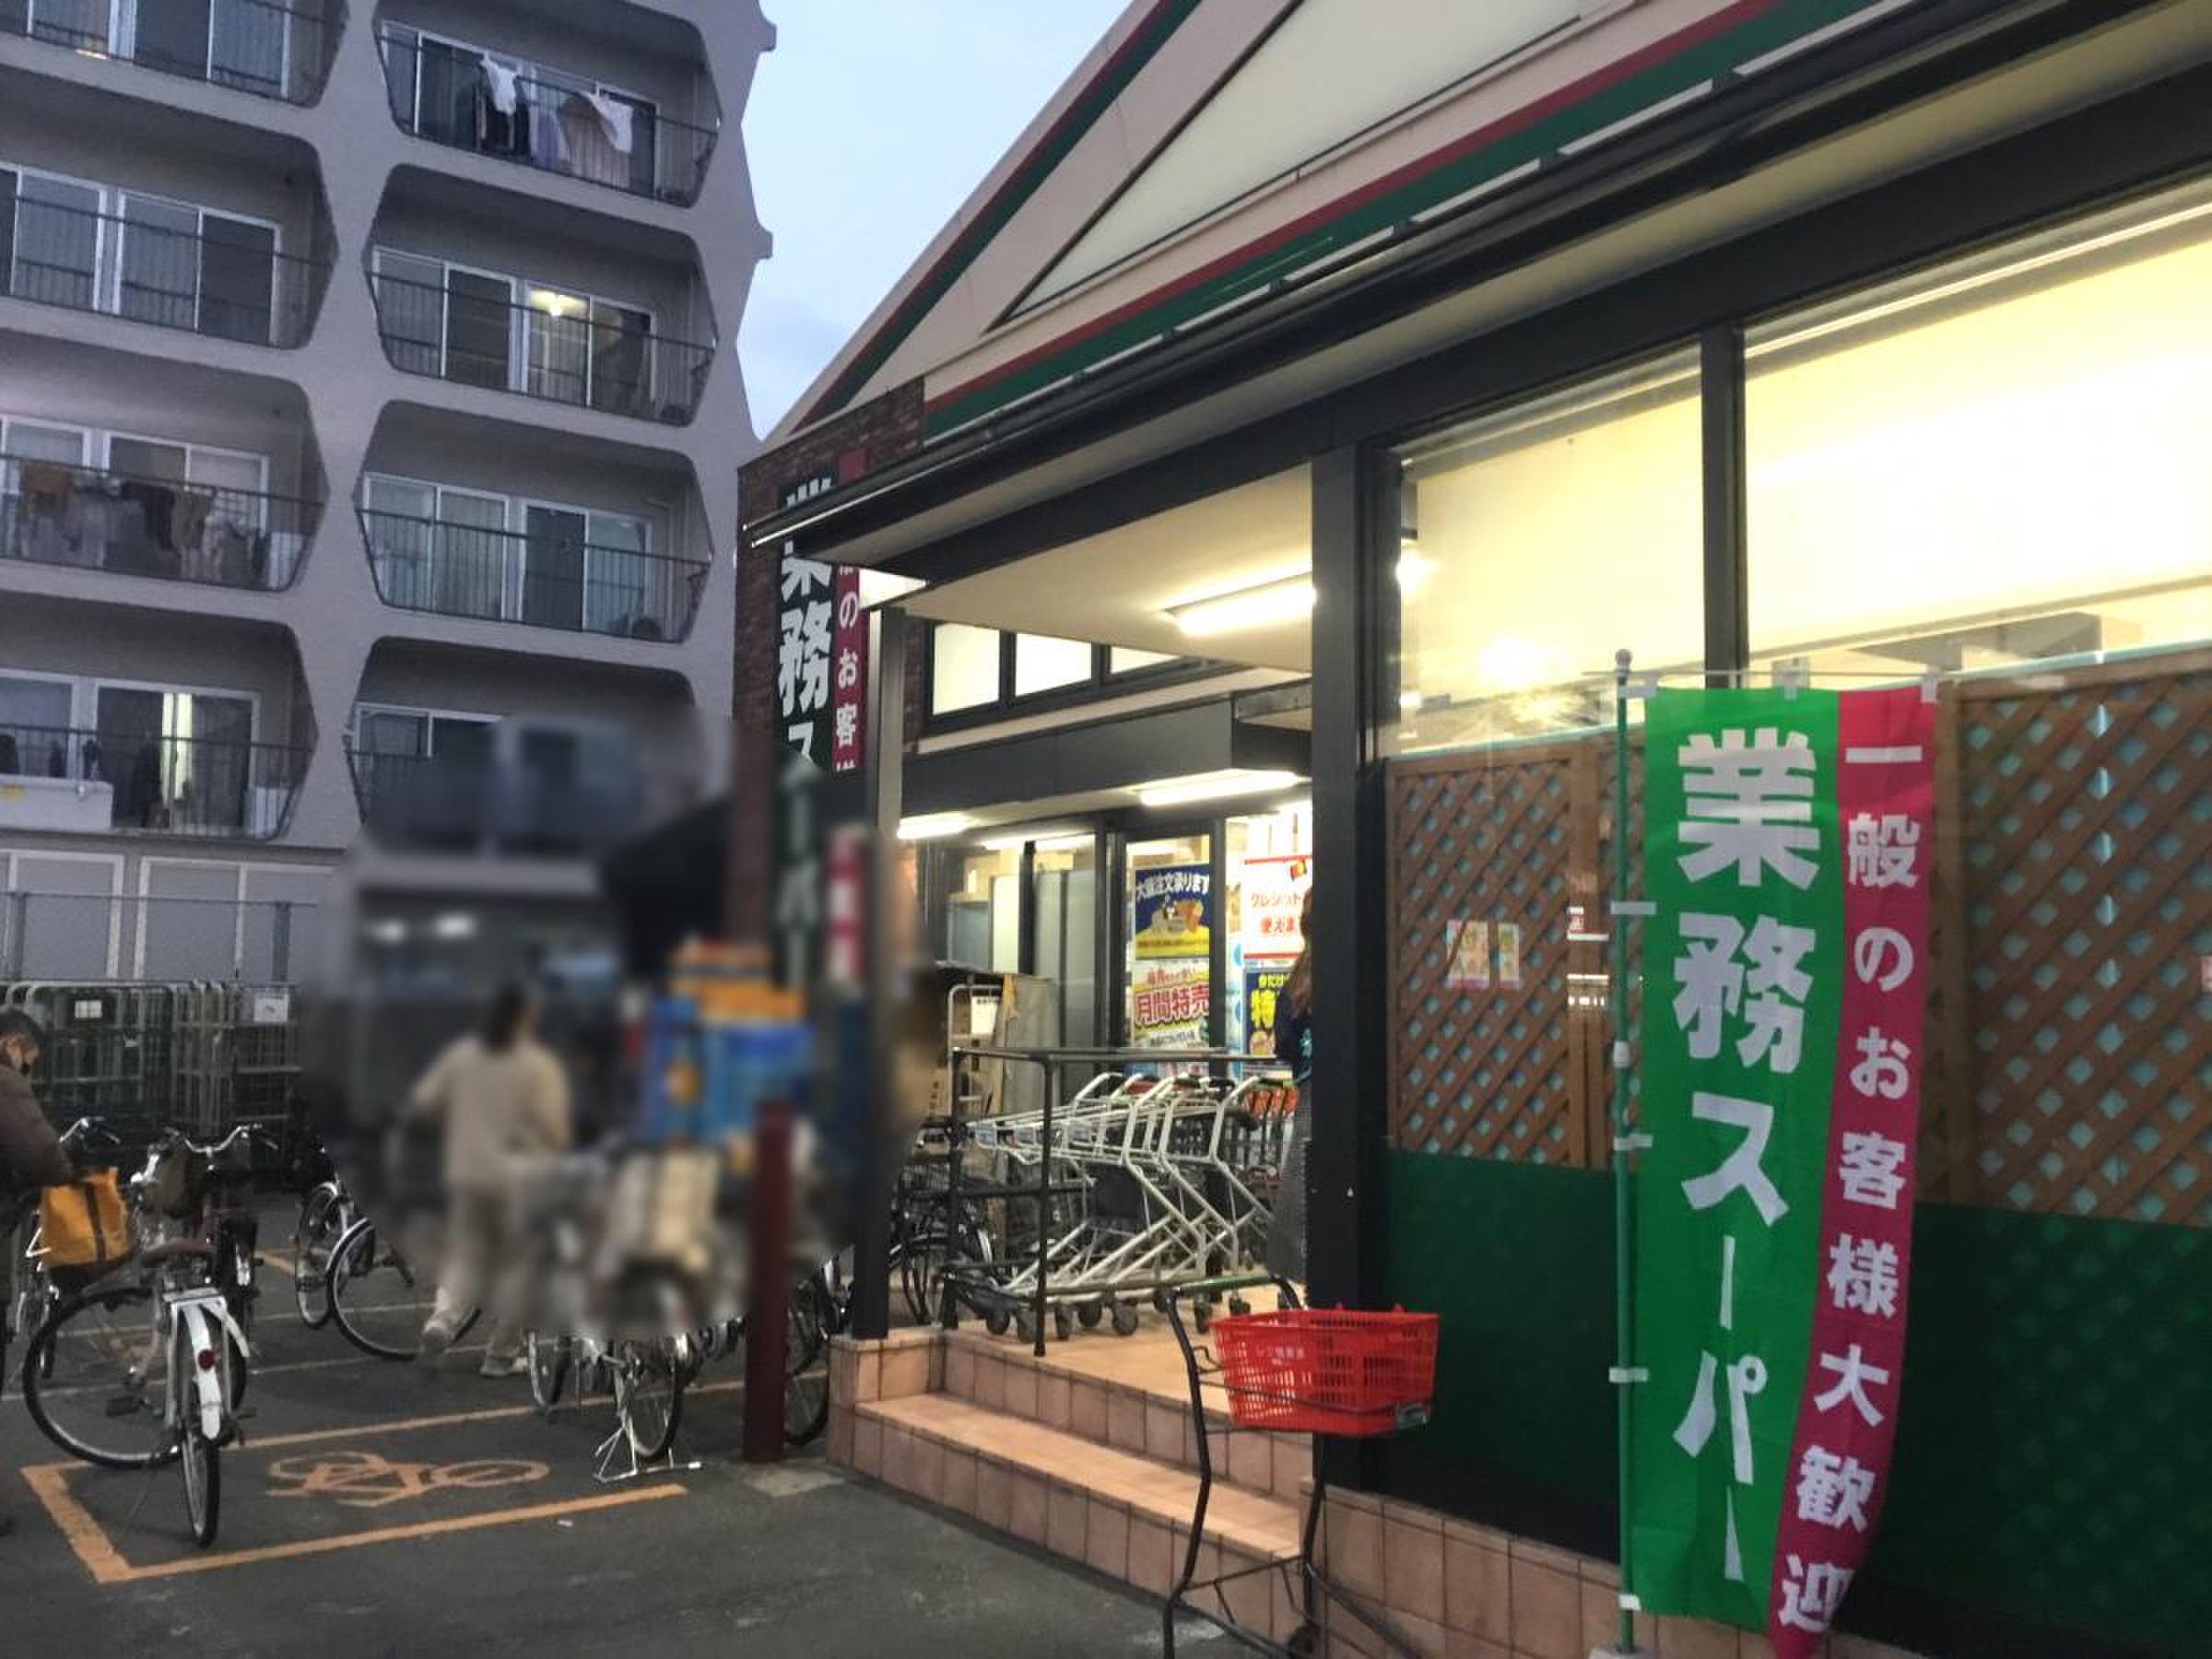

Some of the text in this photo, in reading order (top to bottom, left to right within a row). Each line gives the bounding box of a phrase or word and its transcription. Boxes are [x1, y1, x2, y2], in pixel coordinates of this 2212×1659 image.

[1135, 986, 1209, 1028] 月間特売
[1673, 728, 1821, 1581] 業務スーパー
[1778, 745, 1922, 1632] 一般のお客様大歓迎
